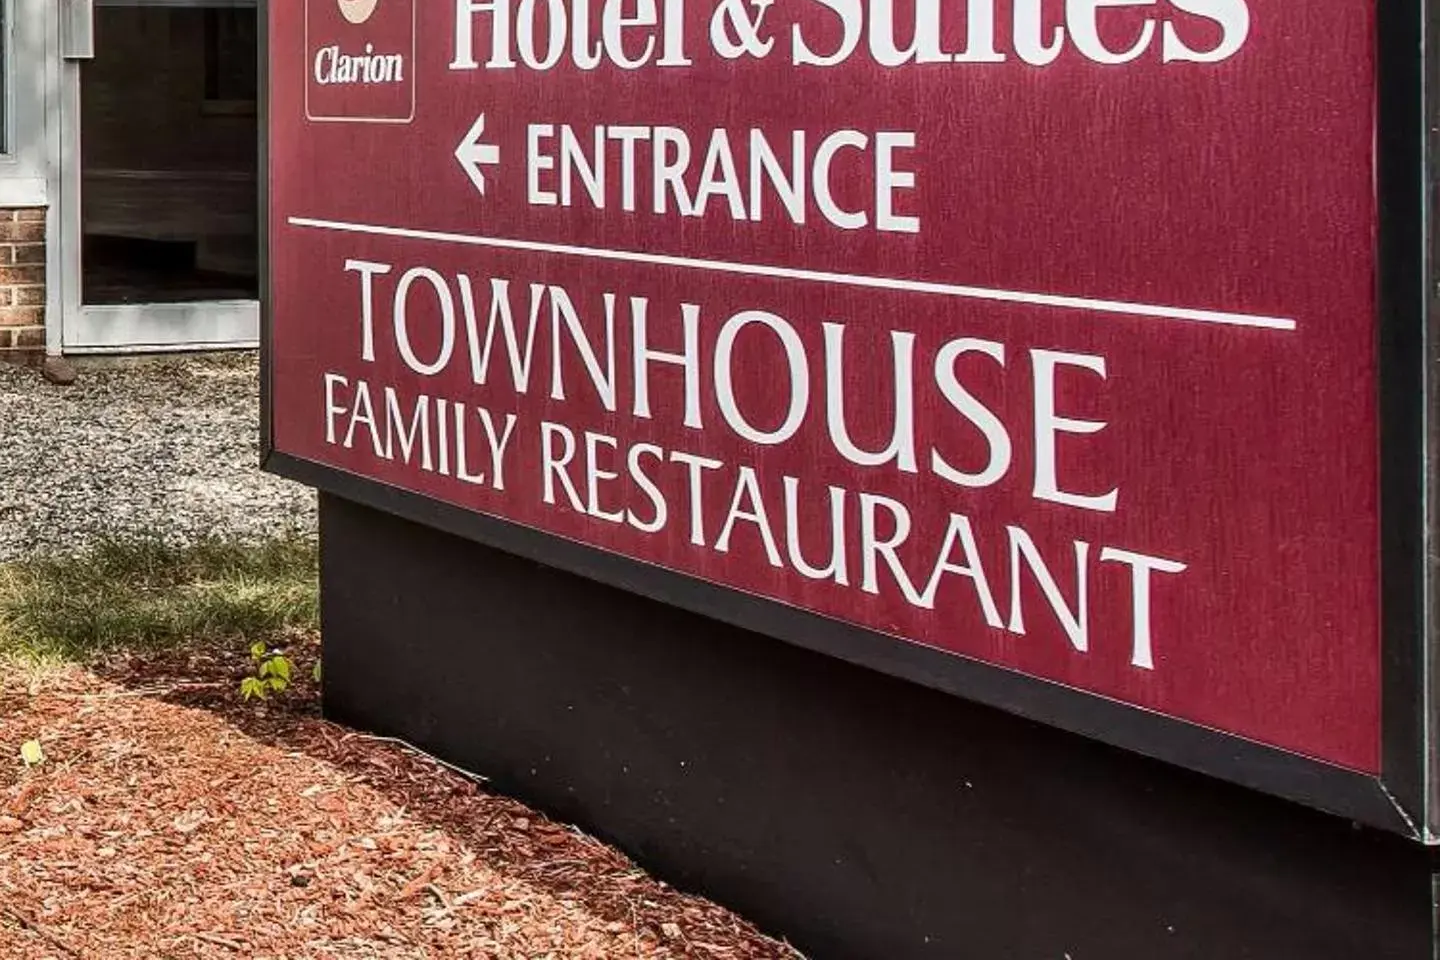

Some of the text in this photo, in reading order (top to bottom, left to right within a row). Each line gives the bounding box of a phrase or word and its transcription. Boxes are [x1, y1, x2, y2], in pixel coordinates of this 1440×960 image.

[314, 43, 404, 85] Clarion
[527, 123, 921, 233] ENTRANCE
[344, 259, 1119, 513] TOWNHOUSE
[324, 372, 1187, 671] FAMILY RESTAURANT
